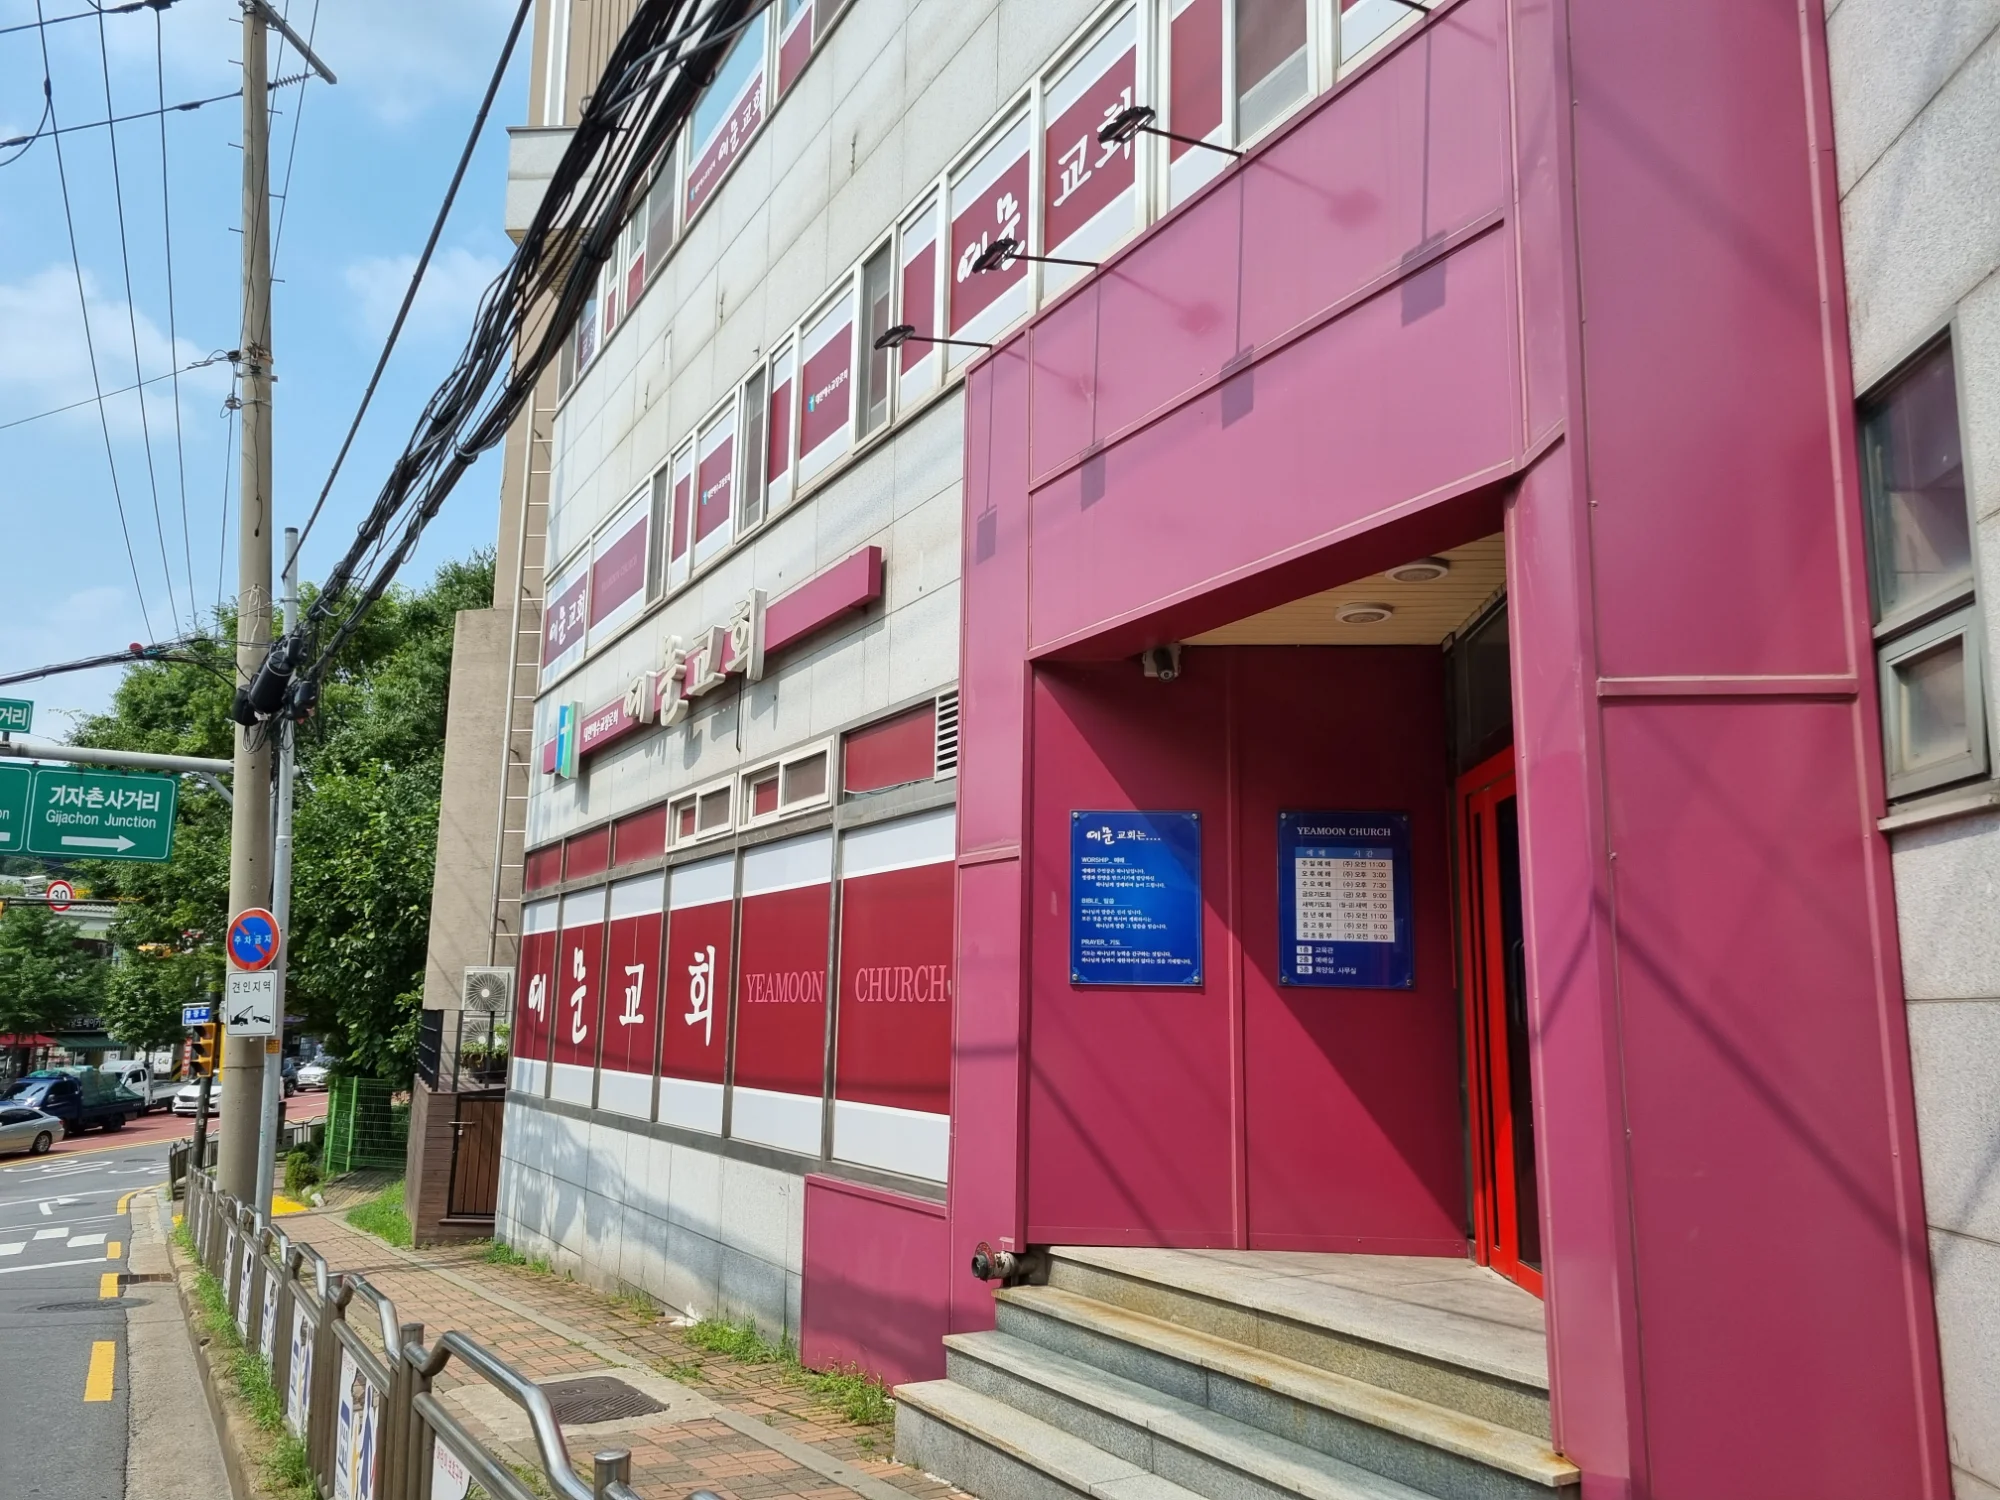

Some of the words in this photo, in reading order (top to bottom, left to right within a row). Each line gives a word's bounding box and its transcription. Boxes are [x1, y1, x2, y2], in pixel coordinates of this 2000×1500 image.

[583, 708, 618, 742] 대한예수교장로회
[49, 785, 161, 812] 기자촌사거리
[46, 809, 99, 827] Gijachon
[105, 813, 157, 829] Junction
[1297, 827, 1345, 836] YEAMOON
[1349, 828, 1391, 836] CHURCH
[52, 889, 68, 901] 30
[234, 934, 272, 945] 주차금지
[232, 980, 272, 993] 견인지역
[745, 970, 825, 1003] YEAMOON
[855, 964, 947, 1003] CHURCH
